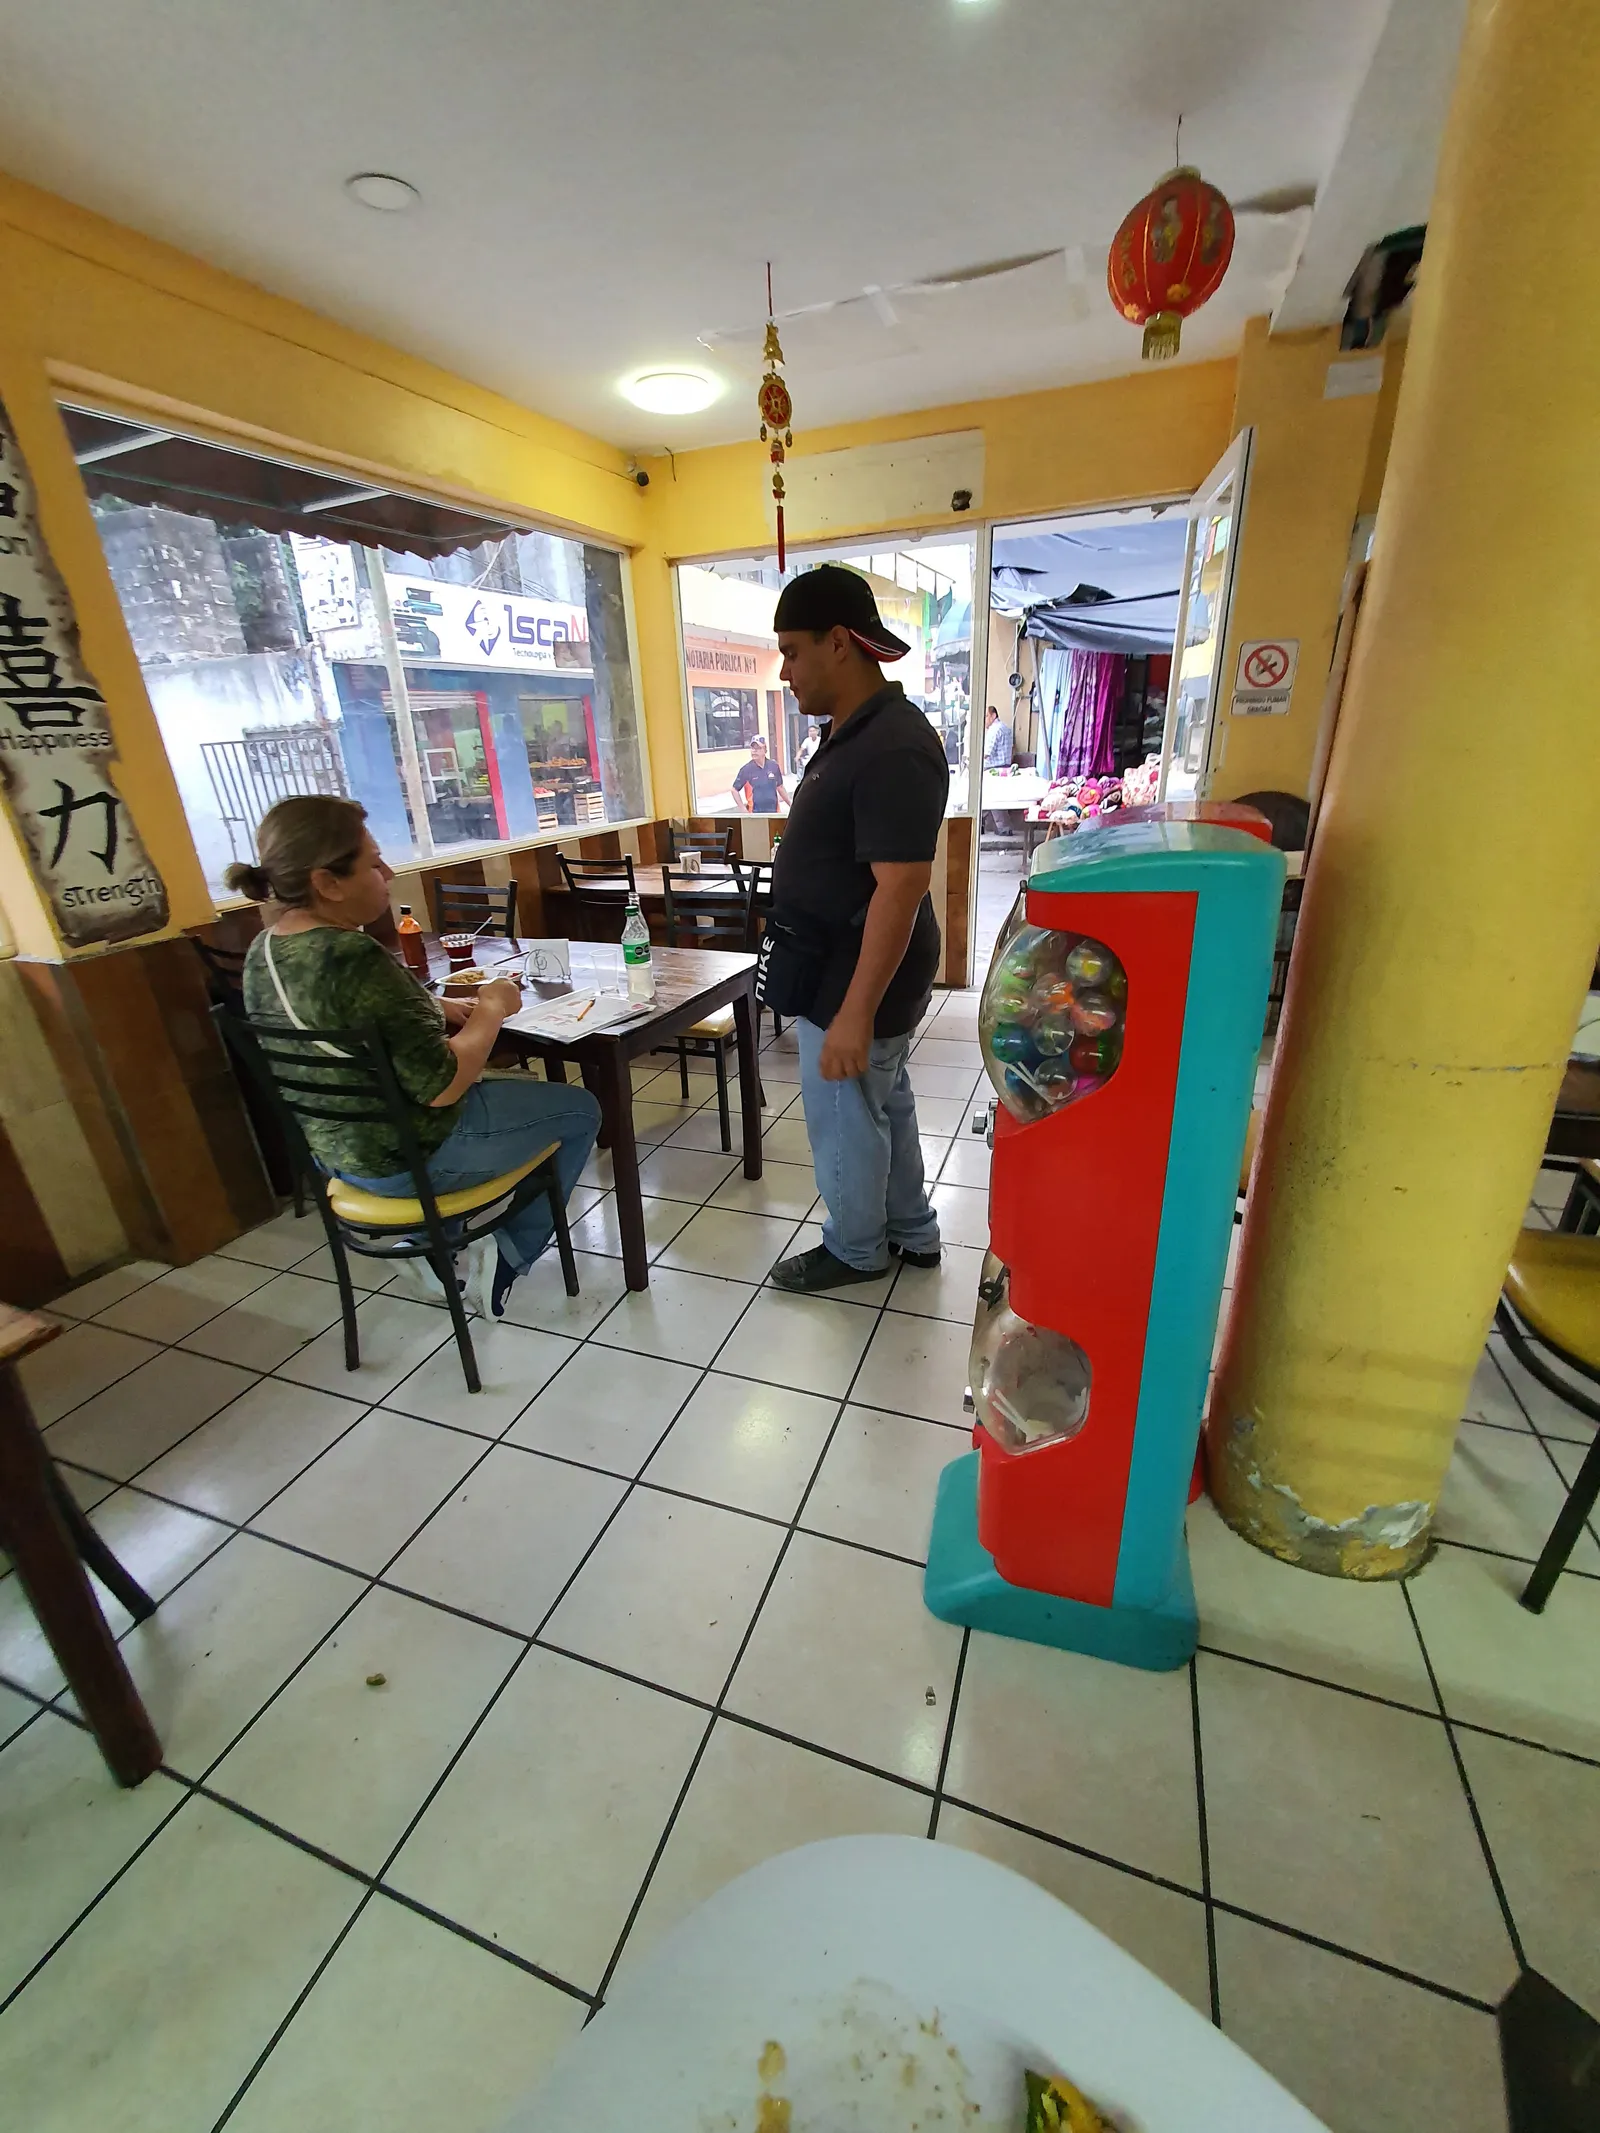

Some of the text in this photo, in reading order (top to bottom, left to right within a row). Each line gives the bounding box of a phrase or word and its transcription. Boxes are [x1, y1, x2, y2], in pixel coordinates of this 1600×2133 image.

[0, 728, 112, 756] Happiness
[37, 779, 122, 876] 力
[62, 873, 163, 908] strength
[755, 936, 775, 1002] NIKE
